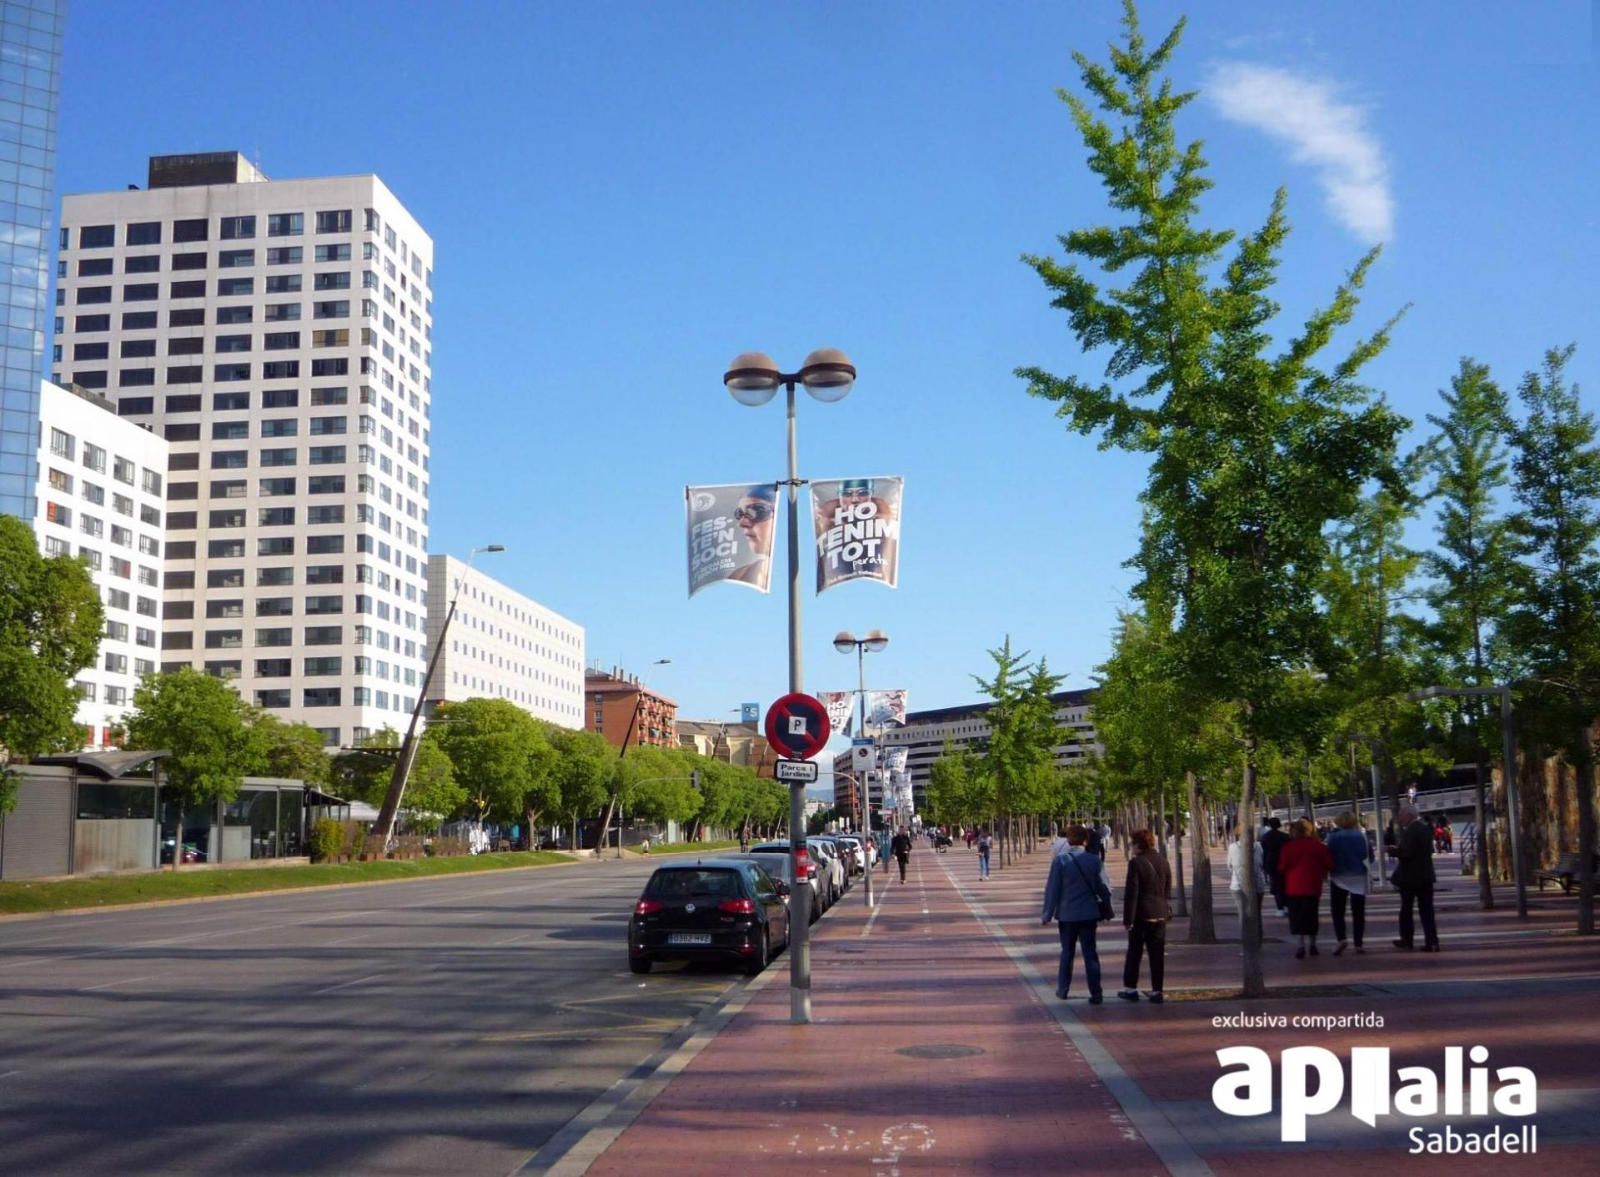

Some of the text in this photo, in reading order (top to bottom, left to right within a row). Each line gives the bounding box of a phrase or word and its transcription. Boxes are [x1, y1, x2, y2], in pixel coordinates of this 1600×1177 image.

[834, 501, 878, 525] HO
[816, 519, 898, 558] TENIM
[827, 538, 881, 569] TOT
[691, 540, 738, 571] SOCI
[794, 720, 801, 731] P
